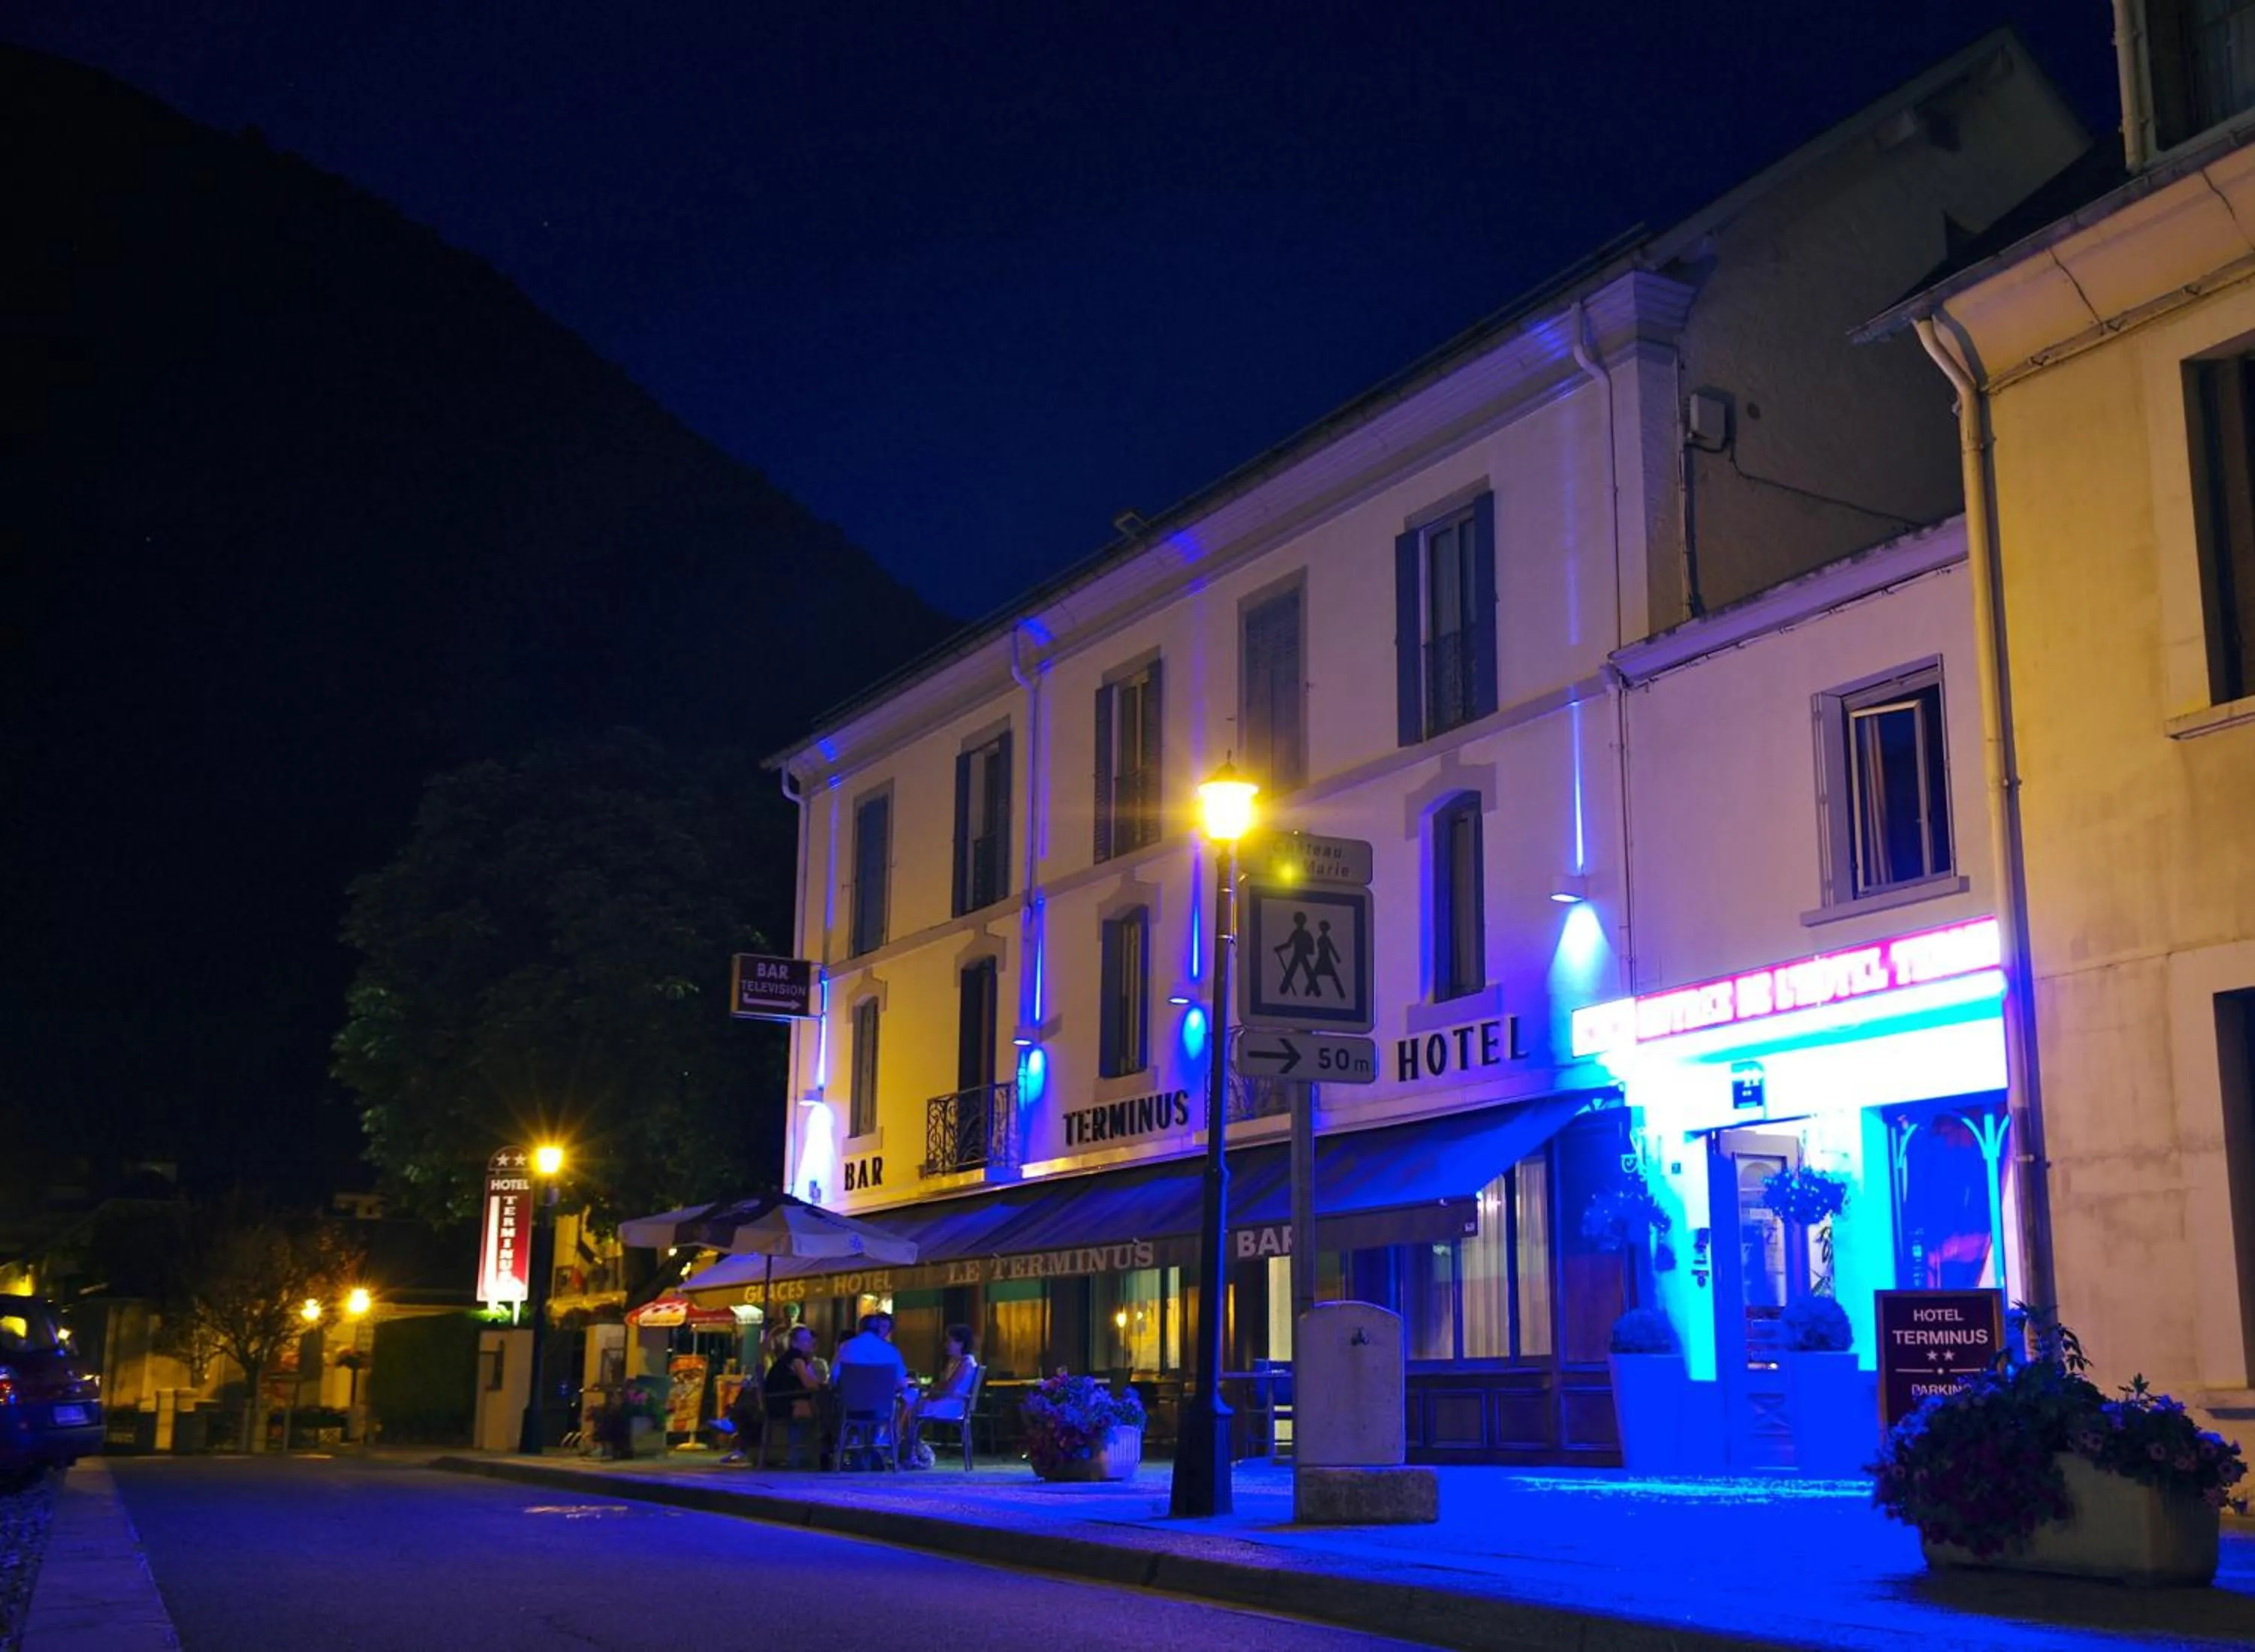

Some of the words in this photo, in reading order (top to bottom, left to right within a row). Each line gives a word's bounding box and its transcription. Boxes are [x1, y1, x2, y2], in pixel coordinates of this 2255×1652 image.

[757, 963, 788, 979] BAR
[741, 979, 806, 997] TELEVISION
[1318, 1047, 1350, 1070] 50
[1355, 1057, 1370, 1073] m
[844, 1156, 883, 1191] BAR
[1062, 1090, 1189, 1146] TERMINUS
[1397, 1017, 1530, 1082] HOTEL
[490, 1178, 531, 1191] HOTEL
[948, 1260, 980, 1284] LE
[990, 1242, 1154, 1280] TERMINUS
[743, 1280, 806, 1303] GLACES
[833, 1270, 893, 1294] HOTEL
[1913, 1309, 1965, 1322] HOTEL
[1892, 1329, 1989, 1345] TERMINUS
[1911, 1384, 1972, 1396] PARKIN
